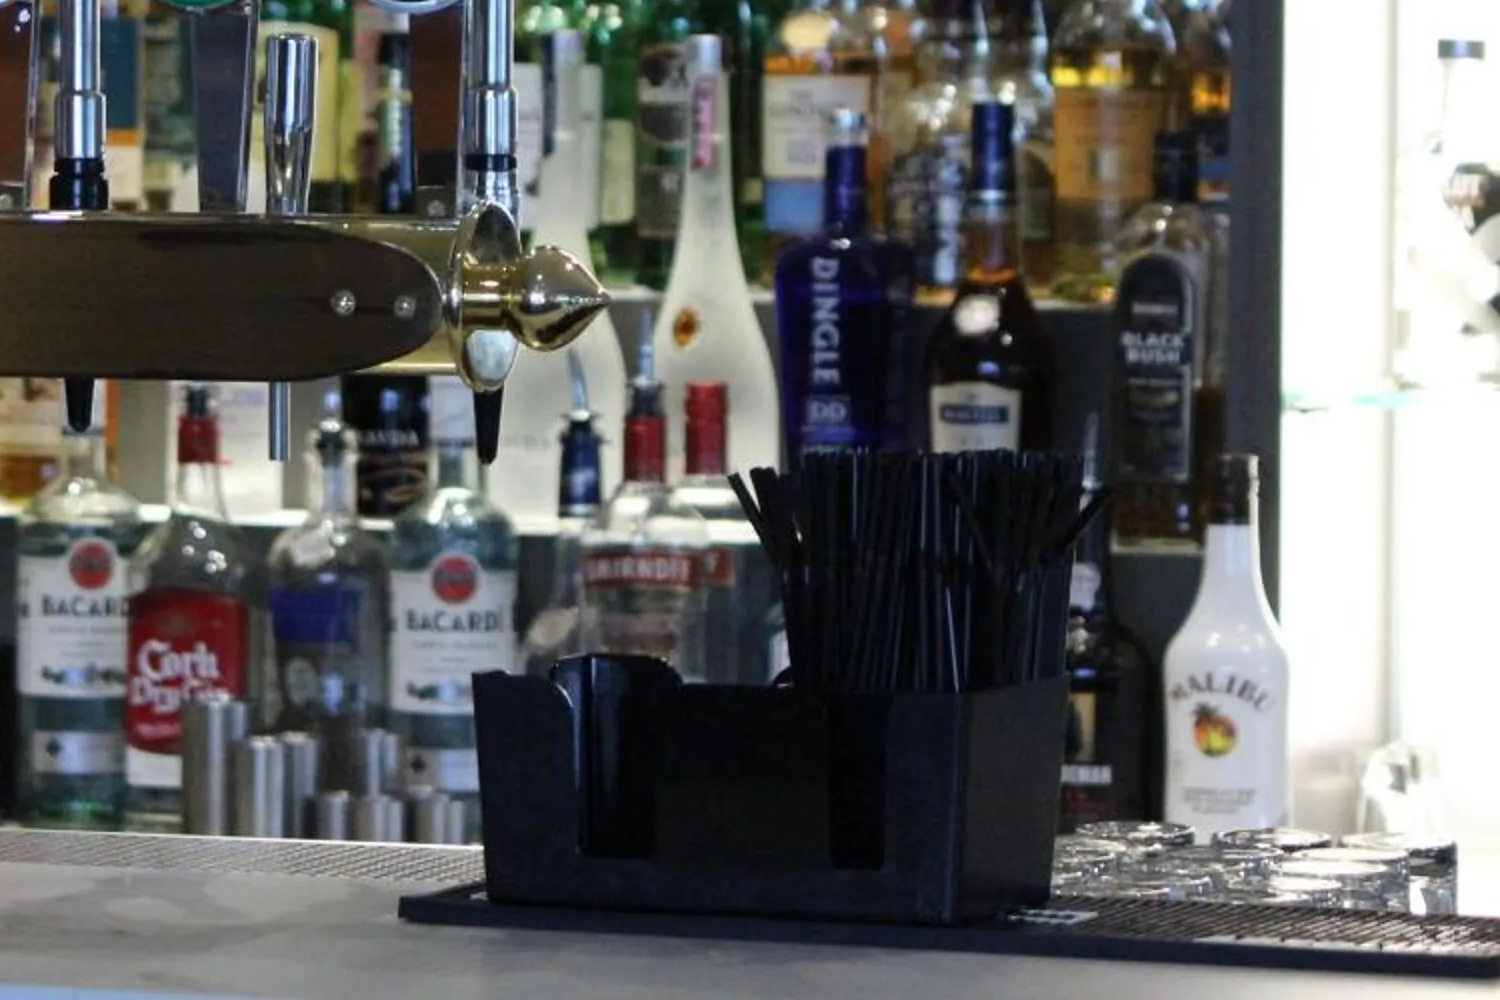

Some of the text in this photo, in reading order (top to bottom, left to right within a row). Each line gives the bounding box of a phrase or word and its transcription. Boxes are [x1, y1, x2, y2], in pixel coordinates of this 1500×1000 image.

[812, 256, 840, 385] DINGLE
[136, 640, 219, 681] Cork
[1171, 672, 1276, 714] MALIBU
